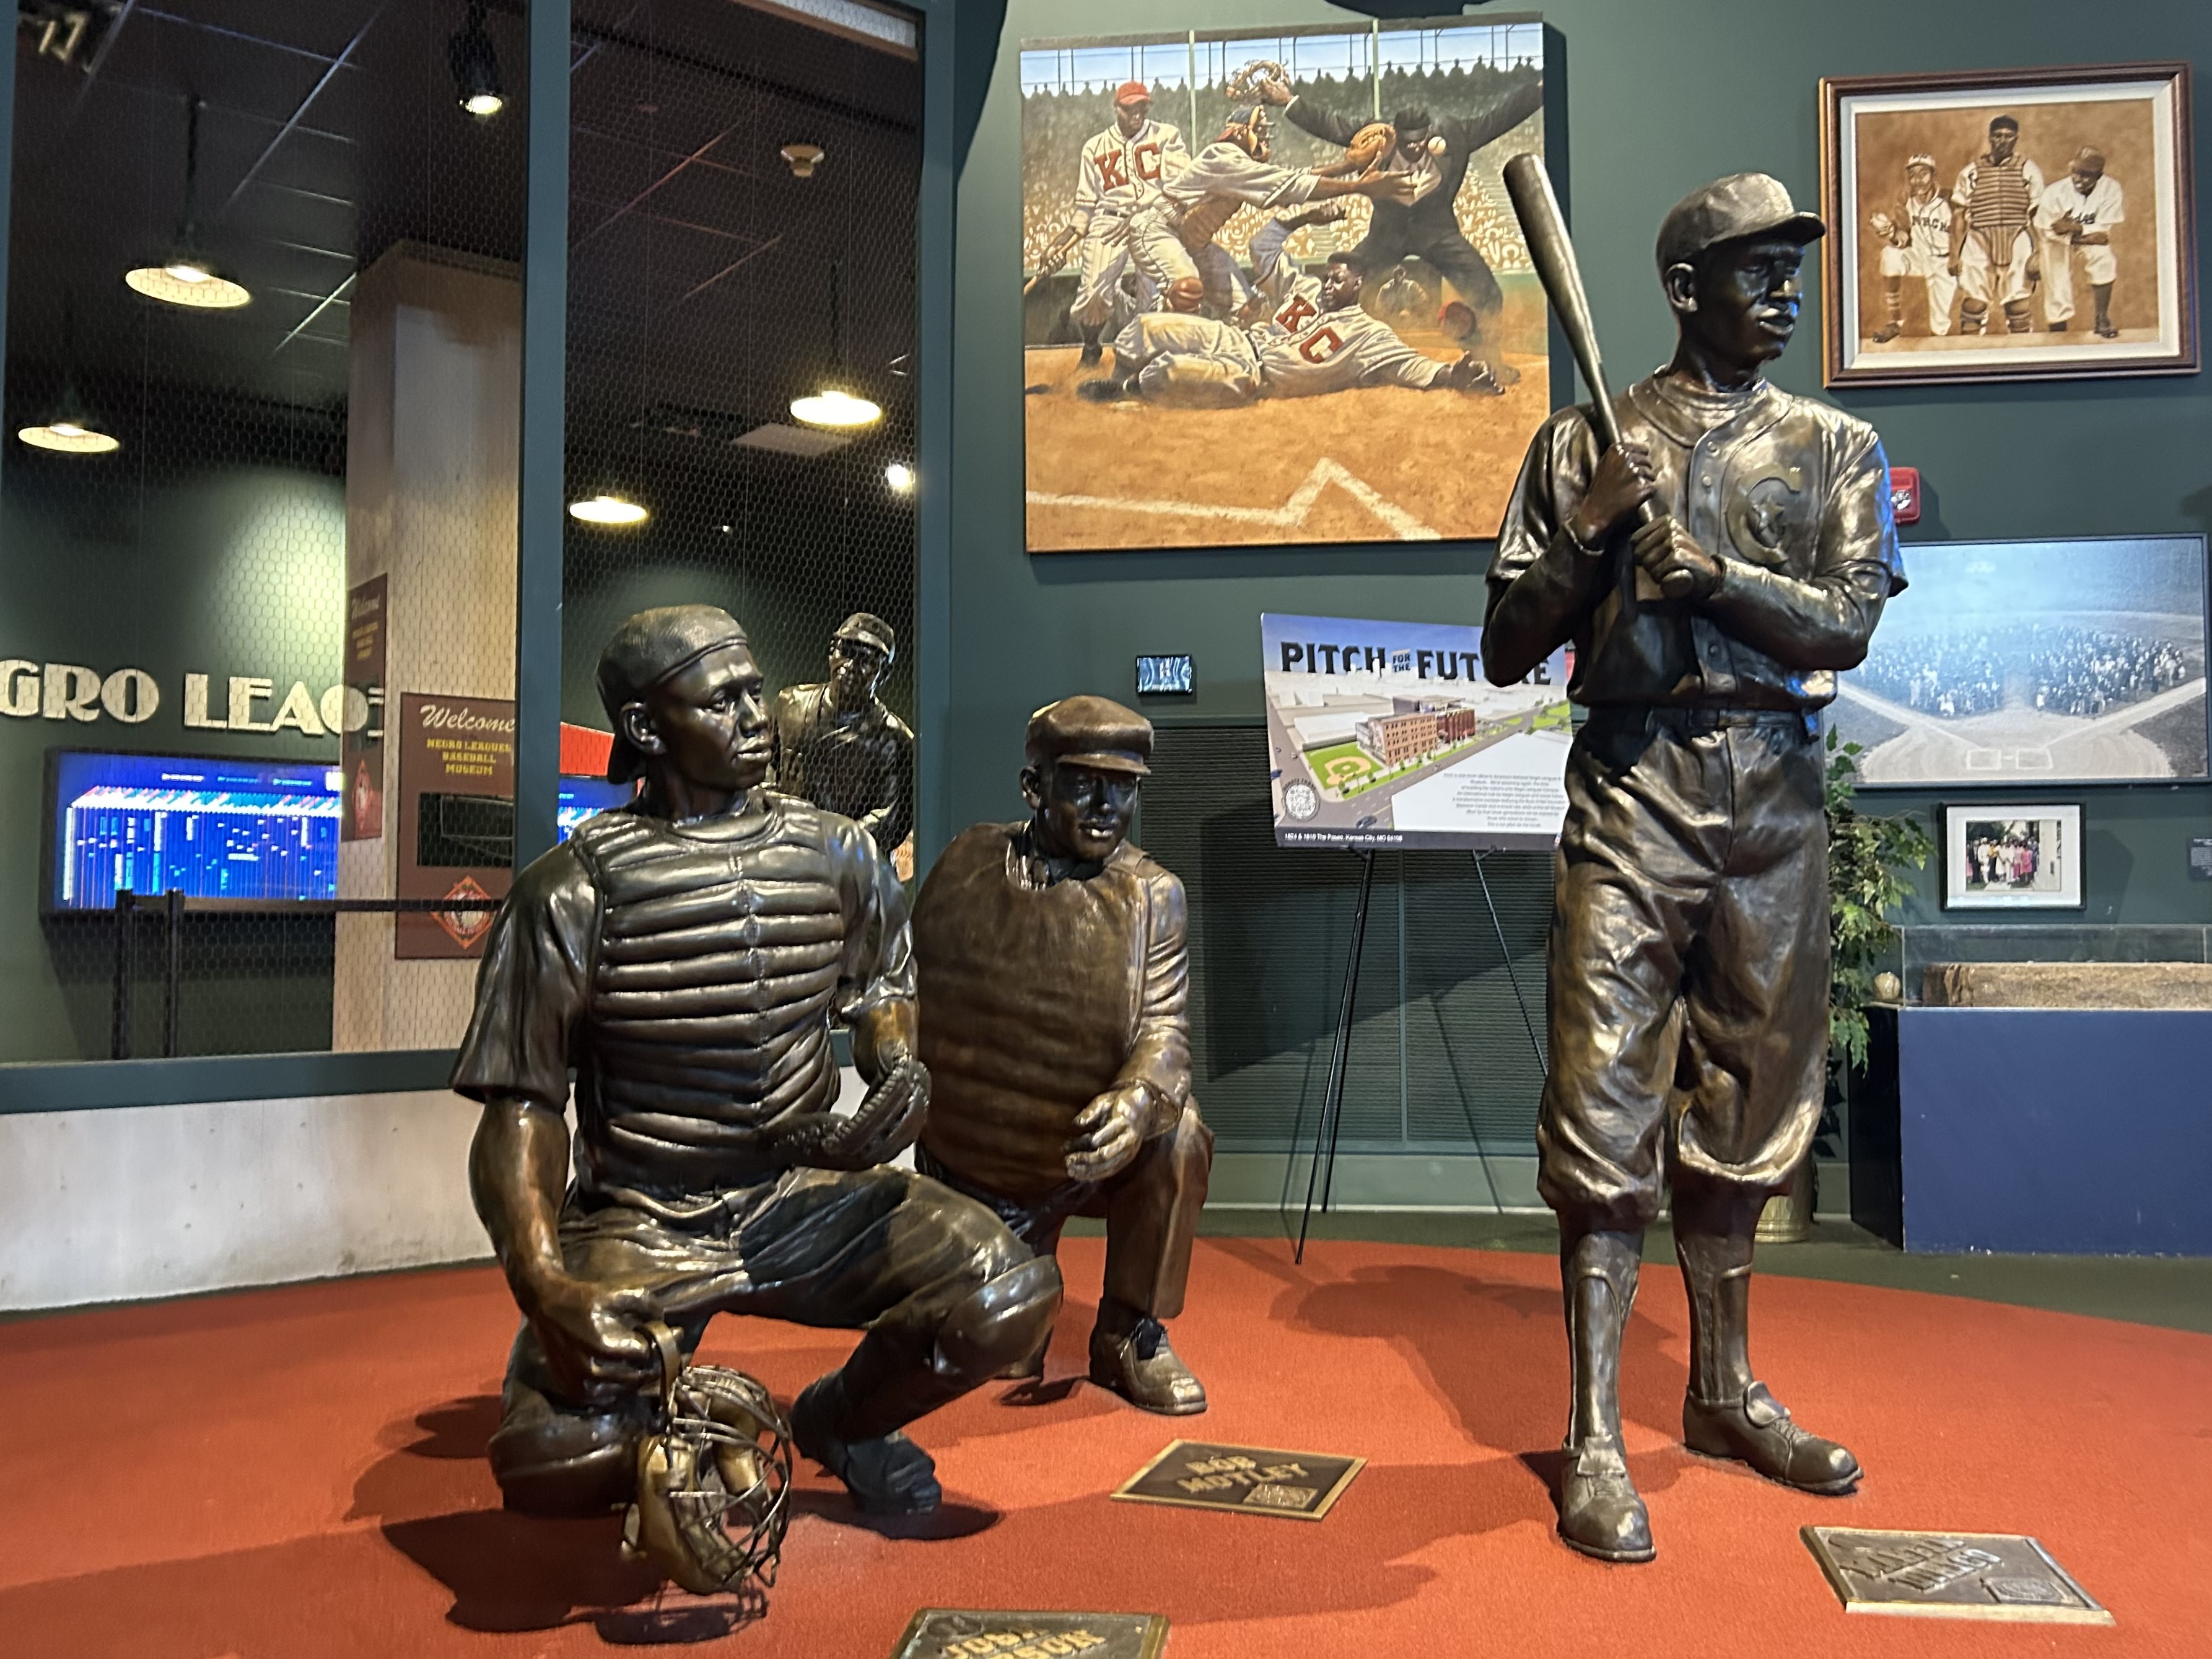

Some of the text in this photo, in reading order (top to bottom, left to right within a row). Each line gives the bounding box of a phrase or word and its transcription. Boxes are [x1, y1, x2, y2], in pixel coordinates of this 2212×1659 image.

[1281, 642, 1552, 686] PITCH FOR THE FUTE
[426, 738, 512, 753] NEGRO LEAGUES
[442, 751, 496, 764] BASEBALL
[445, 763, 493, 776] MUSEUM
[1178, 1463, 1309, 1493] MOTLEY
